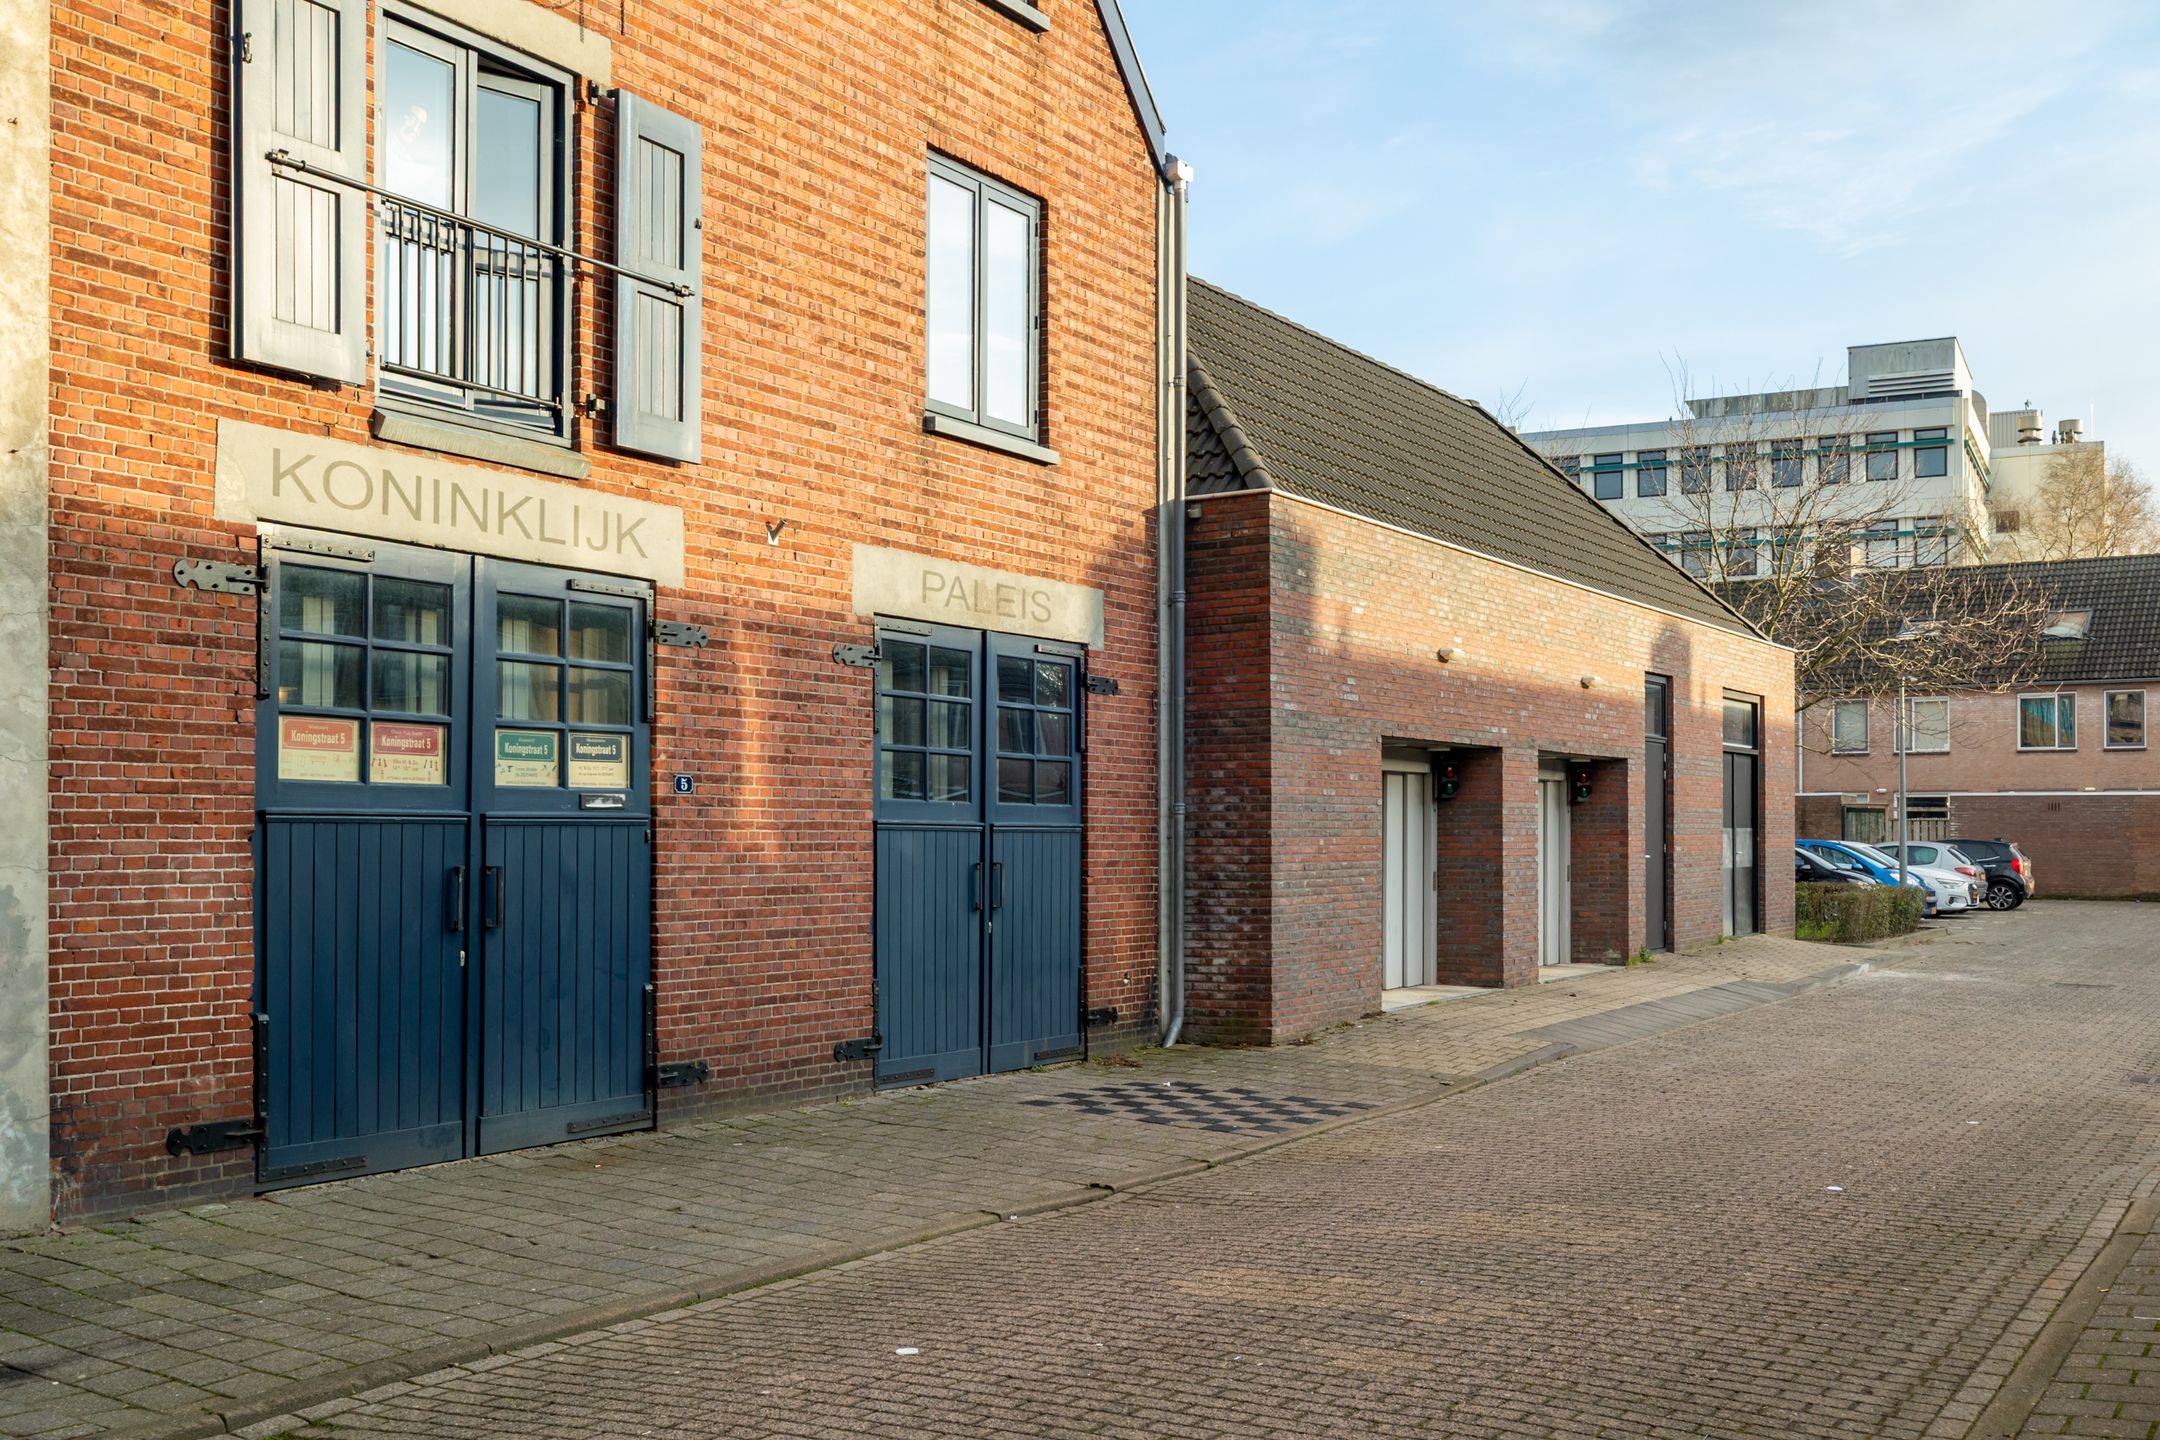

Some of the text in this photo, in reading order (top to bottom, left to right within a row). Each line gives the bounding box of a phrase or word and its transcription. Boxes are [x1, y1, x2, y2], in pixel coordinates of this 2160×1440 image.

[271, 447, 648, 559] KONINKLIJK
[920, 569, 1052, 624] PALEIS
[291, 729, 346, 746] Koningstraat 5
[381, 735, 432, 750] Koningstraat 5
[504, 741, 548, 756] Koningstraat 5
[612, 744, 617, 755] 5
[680, 777, 688, 791] 5
